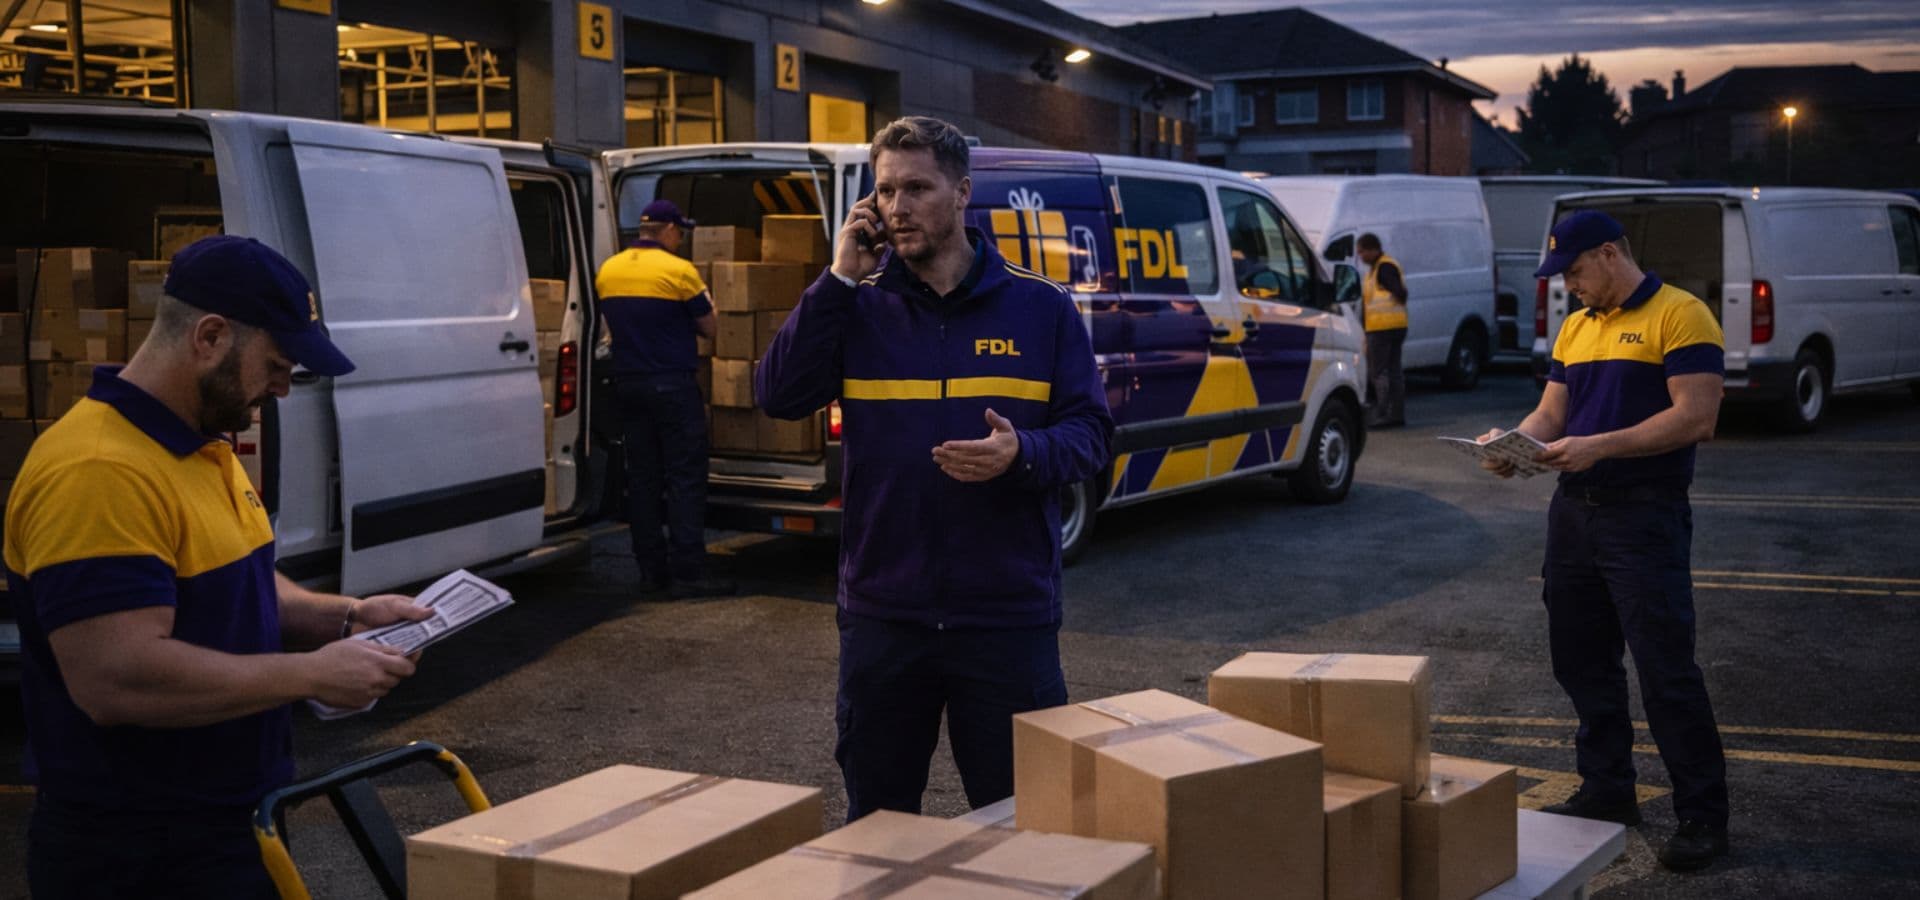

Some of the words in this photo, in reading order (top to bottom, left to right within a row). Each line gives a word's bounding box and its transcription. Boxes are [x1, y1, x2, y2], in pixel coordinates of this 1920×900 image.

[590, 13, 604, 49] 5
[784, 53, 794, 83] 2
[1114, 228, 1189, 278] FDL
[975, 339, 1021, 356] FDL
[1619, 332, 1644, 344] FDL
